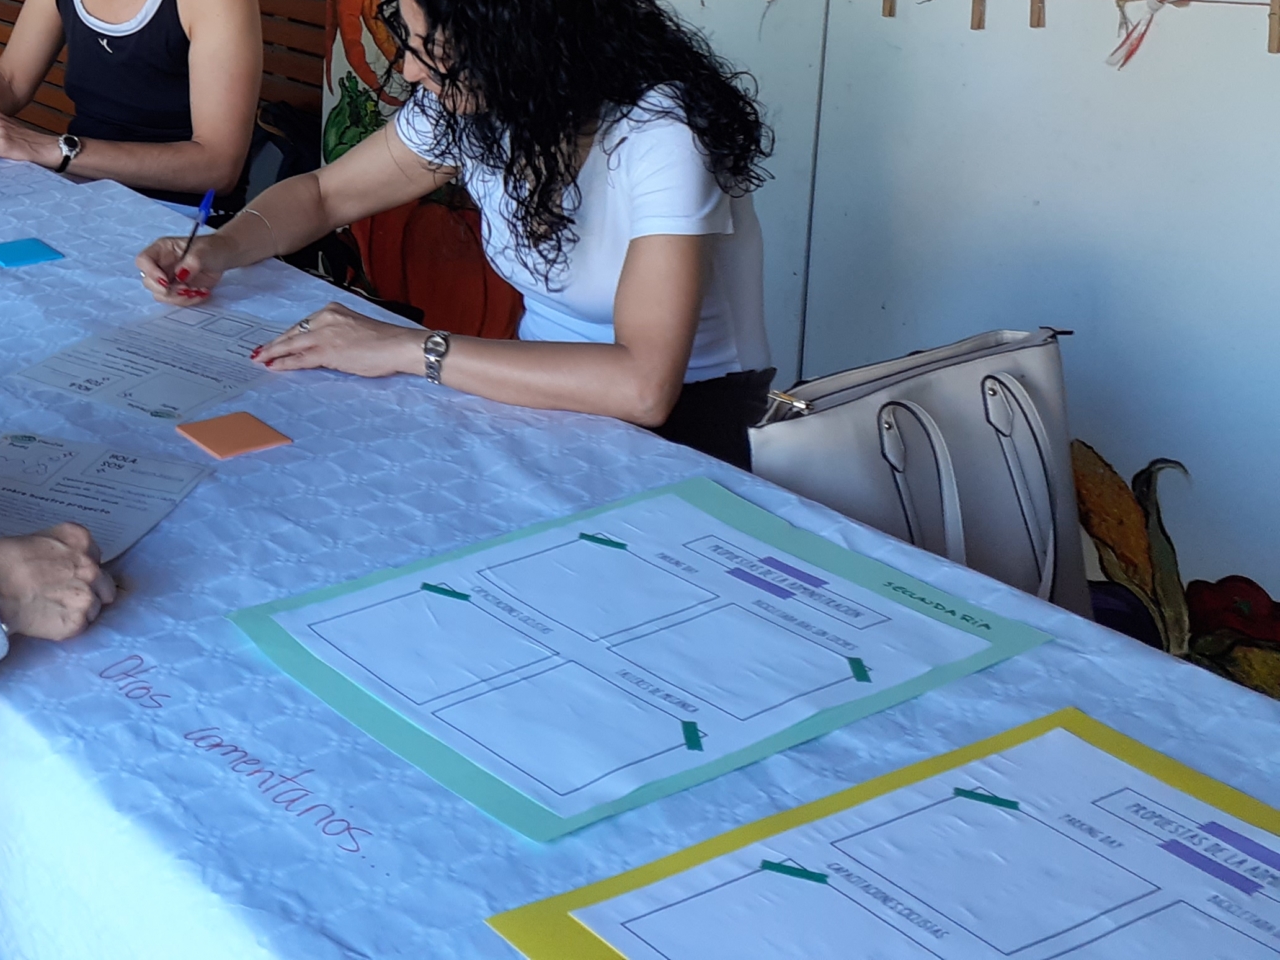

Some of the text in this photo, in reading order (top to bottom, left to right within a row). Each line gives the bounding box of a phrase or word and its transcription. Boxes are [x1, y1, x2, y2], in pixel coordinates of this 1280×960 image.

[99, 653, 172, 710] Otros
[1124, 801, 1211, 848] PROPUESTAS
[1203, 842, 1230, 859] DE
[1223, 852, 1249, 870] LA
